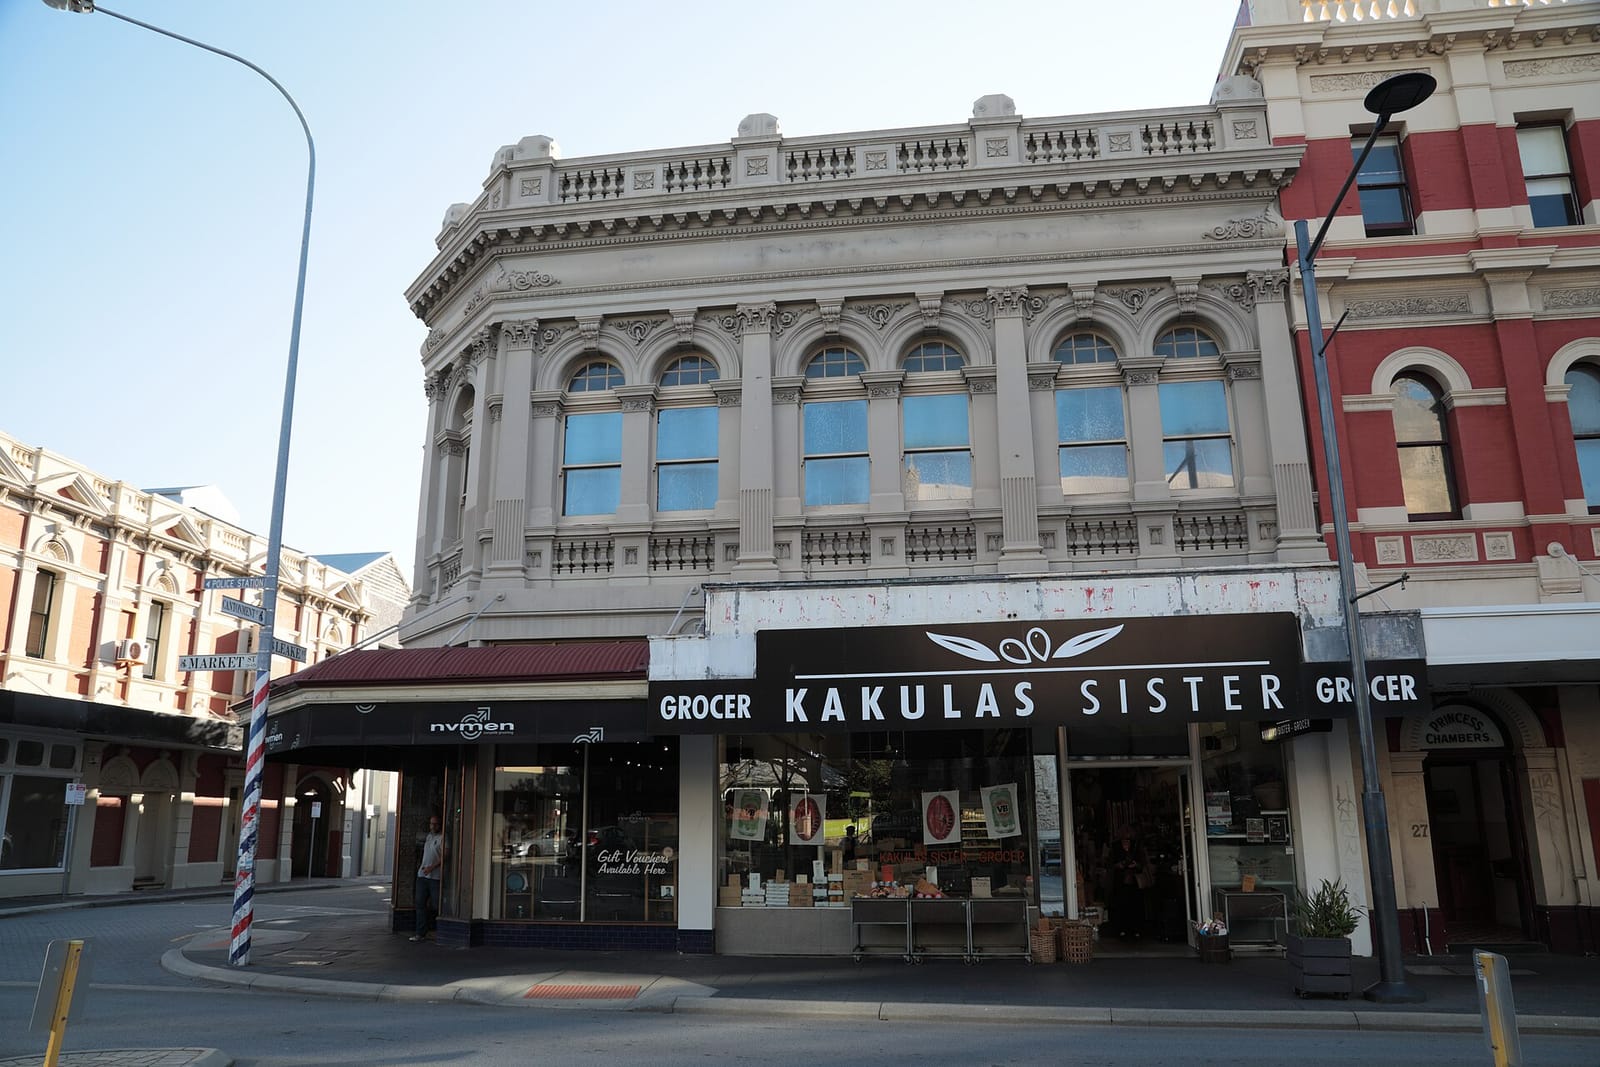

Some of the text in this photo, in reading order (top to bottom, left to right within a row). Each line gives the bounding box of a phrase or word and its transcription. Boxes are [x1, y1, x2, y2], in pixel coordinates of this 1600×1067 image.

[212, 579, 264, 588] POLICE STATION
[275, 641, 301, 660] LEAKE
[189, 656, 245, 669] MARKET
[247, 655, 257, 663] ST
[1316, 674, 1418, 703] GRCER
[785, 674, 1284, 722] KAKULAS SISTER
[660, 693, 751, 720] GROCER
[430, 722, 515, 732] nvmen
[1411, 824, 1428, 838] 27
[597, 849, 669, 864] Gift Vouchers
[879, 850, 1025, 864] KAKULAS SISTER GROCER
[597, 862, 667, 876] Available Here
